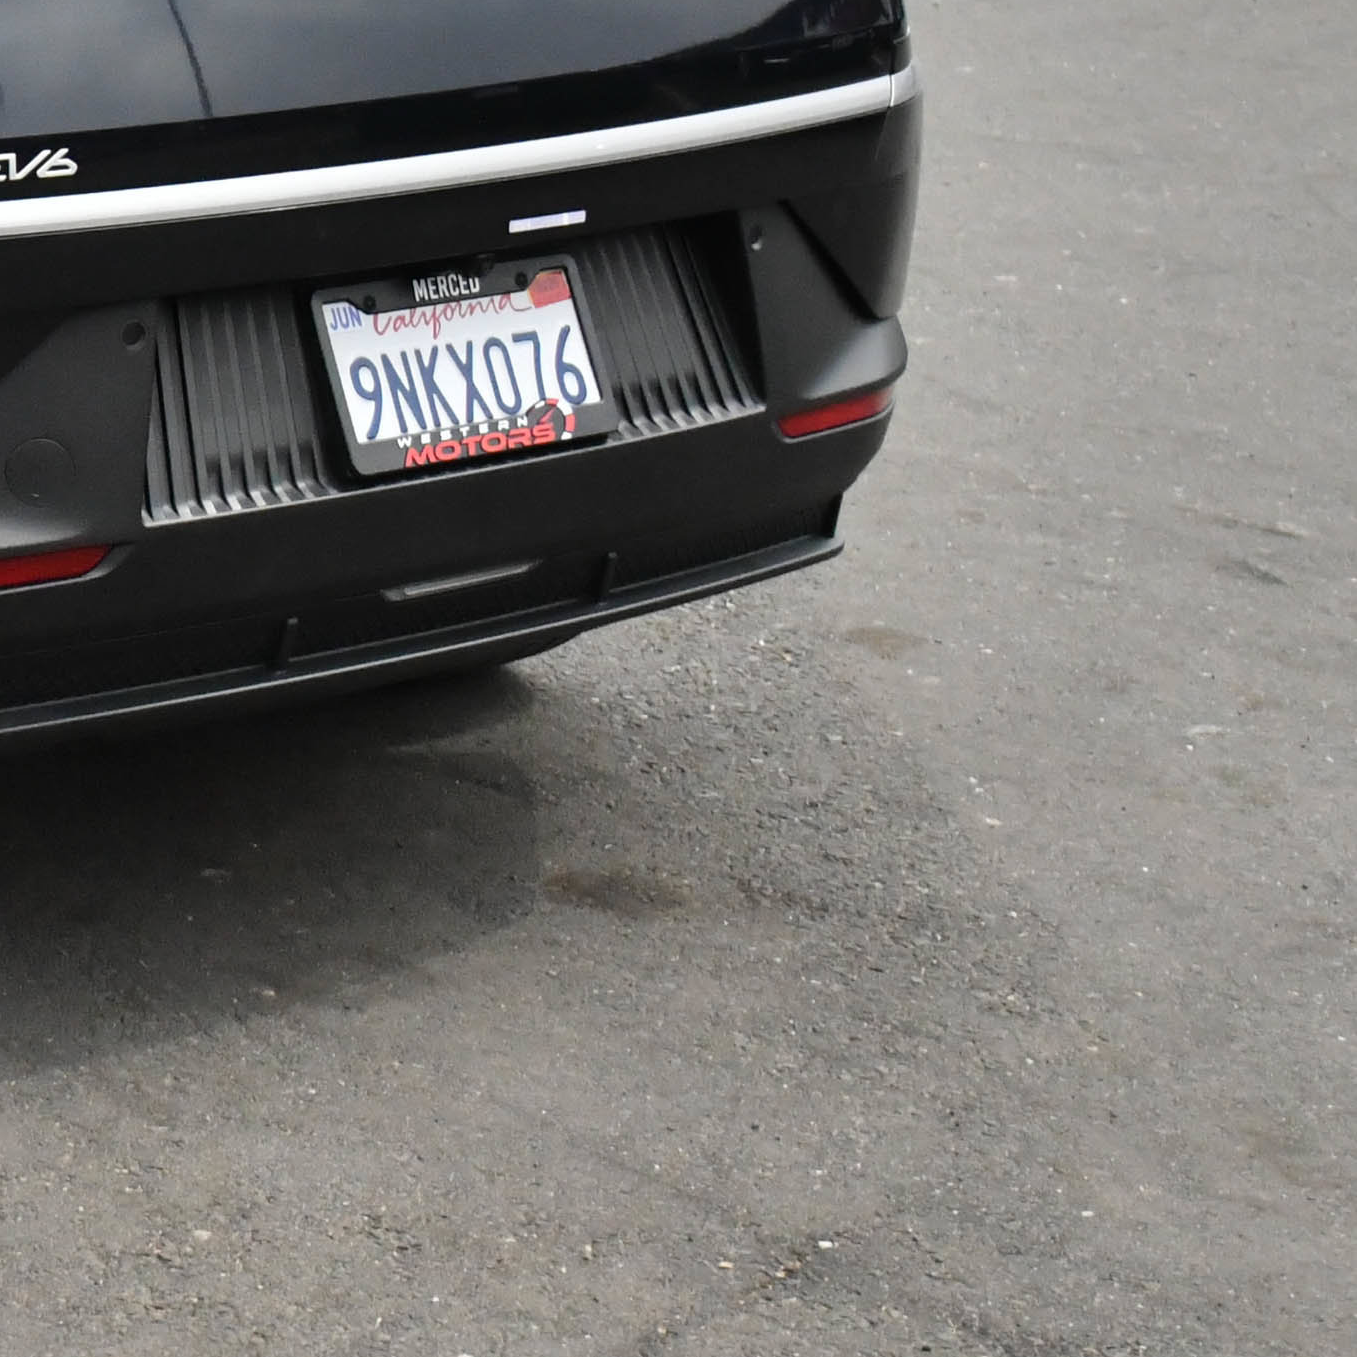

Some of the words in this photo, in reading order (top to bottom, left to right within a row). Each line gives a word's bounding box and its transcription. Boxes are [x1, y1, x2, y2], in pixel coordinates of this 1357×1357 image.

[412, 273, 480, 302] MERCED
[330, 306, 362, 331] JUN
[350, 325, 587, 440] 9NKX076
[397, 416, 528, 448] WESTERN
[405, 421, 557, 468] MOTORS
